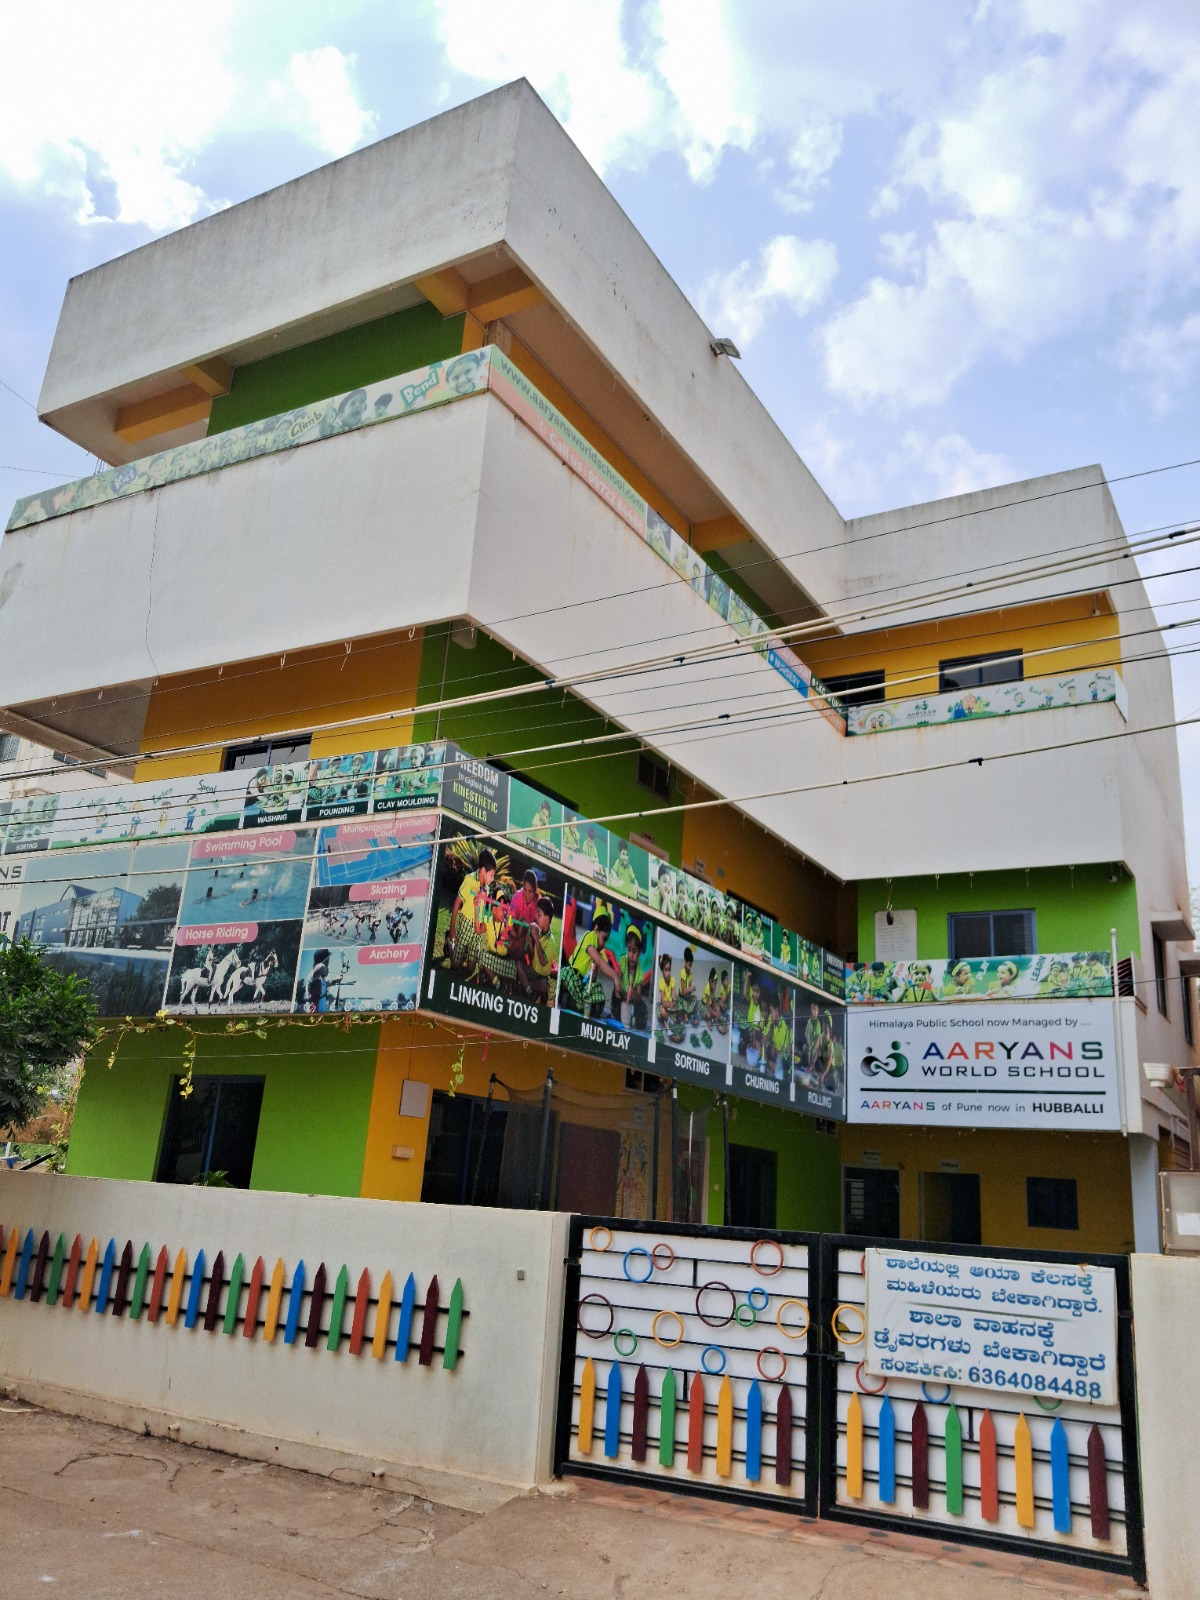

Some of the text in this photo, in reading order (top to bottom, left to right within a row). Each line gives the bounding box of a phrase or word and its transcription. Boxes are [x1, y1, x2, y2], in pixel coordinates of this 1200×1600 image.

[403, 369, 438, 403] Bend
[290, 411, 323, 438] Climb
[500, 358, 645, 513] www.aaryansworldschool.com
[550, 431, 569, 460] Call
[455, 751, 499, 787] FREEDOM
[377, 796, 436, 810] CLAY MOULDING
[453, 781, 498, 814] KINESTHETIC
[257, 813, 288, 824] WASHING
[319, 805, 355, 817] POUNDING
[463, 801, 487, 822] SKILLS
[342, 816, 432, 836] Multipurpose Synthetic
[16, 842, 38, 851] SORTING
[205, 835, 283, 853] Swimming Pool
[370, 884, 408, 896] Skating
[185, 926, 249, 940] Horse Riding
[369, 948, 409, 961] Archery
[1030, 955, 1047, 982] LEARN
[450, 982, 539, 1024] LINKING TOYS
[869, 1019, 914, 1030] Himalaya
[916, 1019, 948, 1028] Public
[949, 1018, 984, 1027] School
[986, 1019, 1010, 1027] now
[1012, 1018, 1062, 1028] Managed
[1065, 1017, 1078, 1028] by
[580, 1021, 631, 1051] MUD PLAY
[922, 1041, 1103, 1060] AARYANS
[674, 1052, 710, 1075] SORTING
[922, 1066, 1105, 1078] WORLD SCHOOL
[745, 1073, 780, 1094] CHURNING
[807, 1091, 832, 1109] ROLLING
[860, 1100, 1104, 1114] AARYANS of Pune now in HUBBALLI
[886, 1257, 1093, 1295] ಶಾಲೆಯಲ್ಲಿ ಆಯಾ ಕೆಲಸಕ್ಕೆ
[886, 1278, 1103, 1318] ಮಹಿಳೆಯರು ಬೇಕಾಗಿದ್ದಾರೆ.
[909, 1310, 1055, 1348] ಶಾಲಾ ವಾಹನಕ್ಕೆ
[873, 1327, 1106, 1377] ಡ್ರೈವರಗಳು ಬೇಕಾಗಿದ್ದಾರೆ
[880, 1356, 1102, 1399] ಸಂಪರ್ಕಿಸಿ: 6364084488
